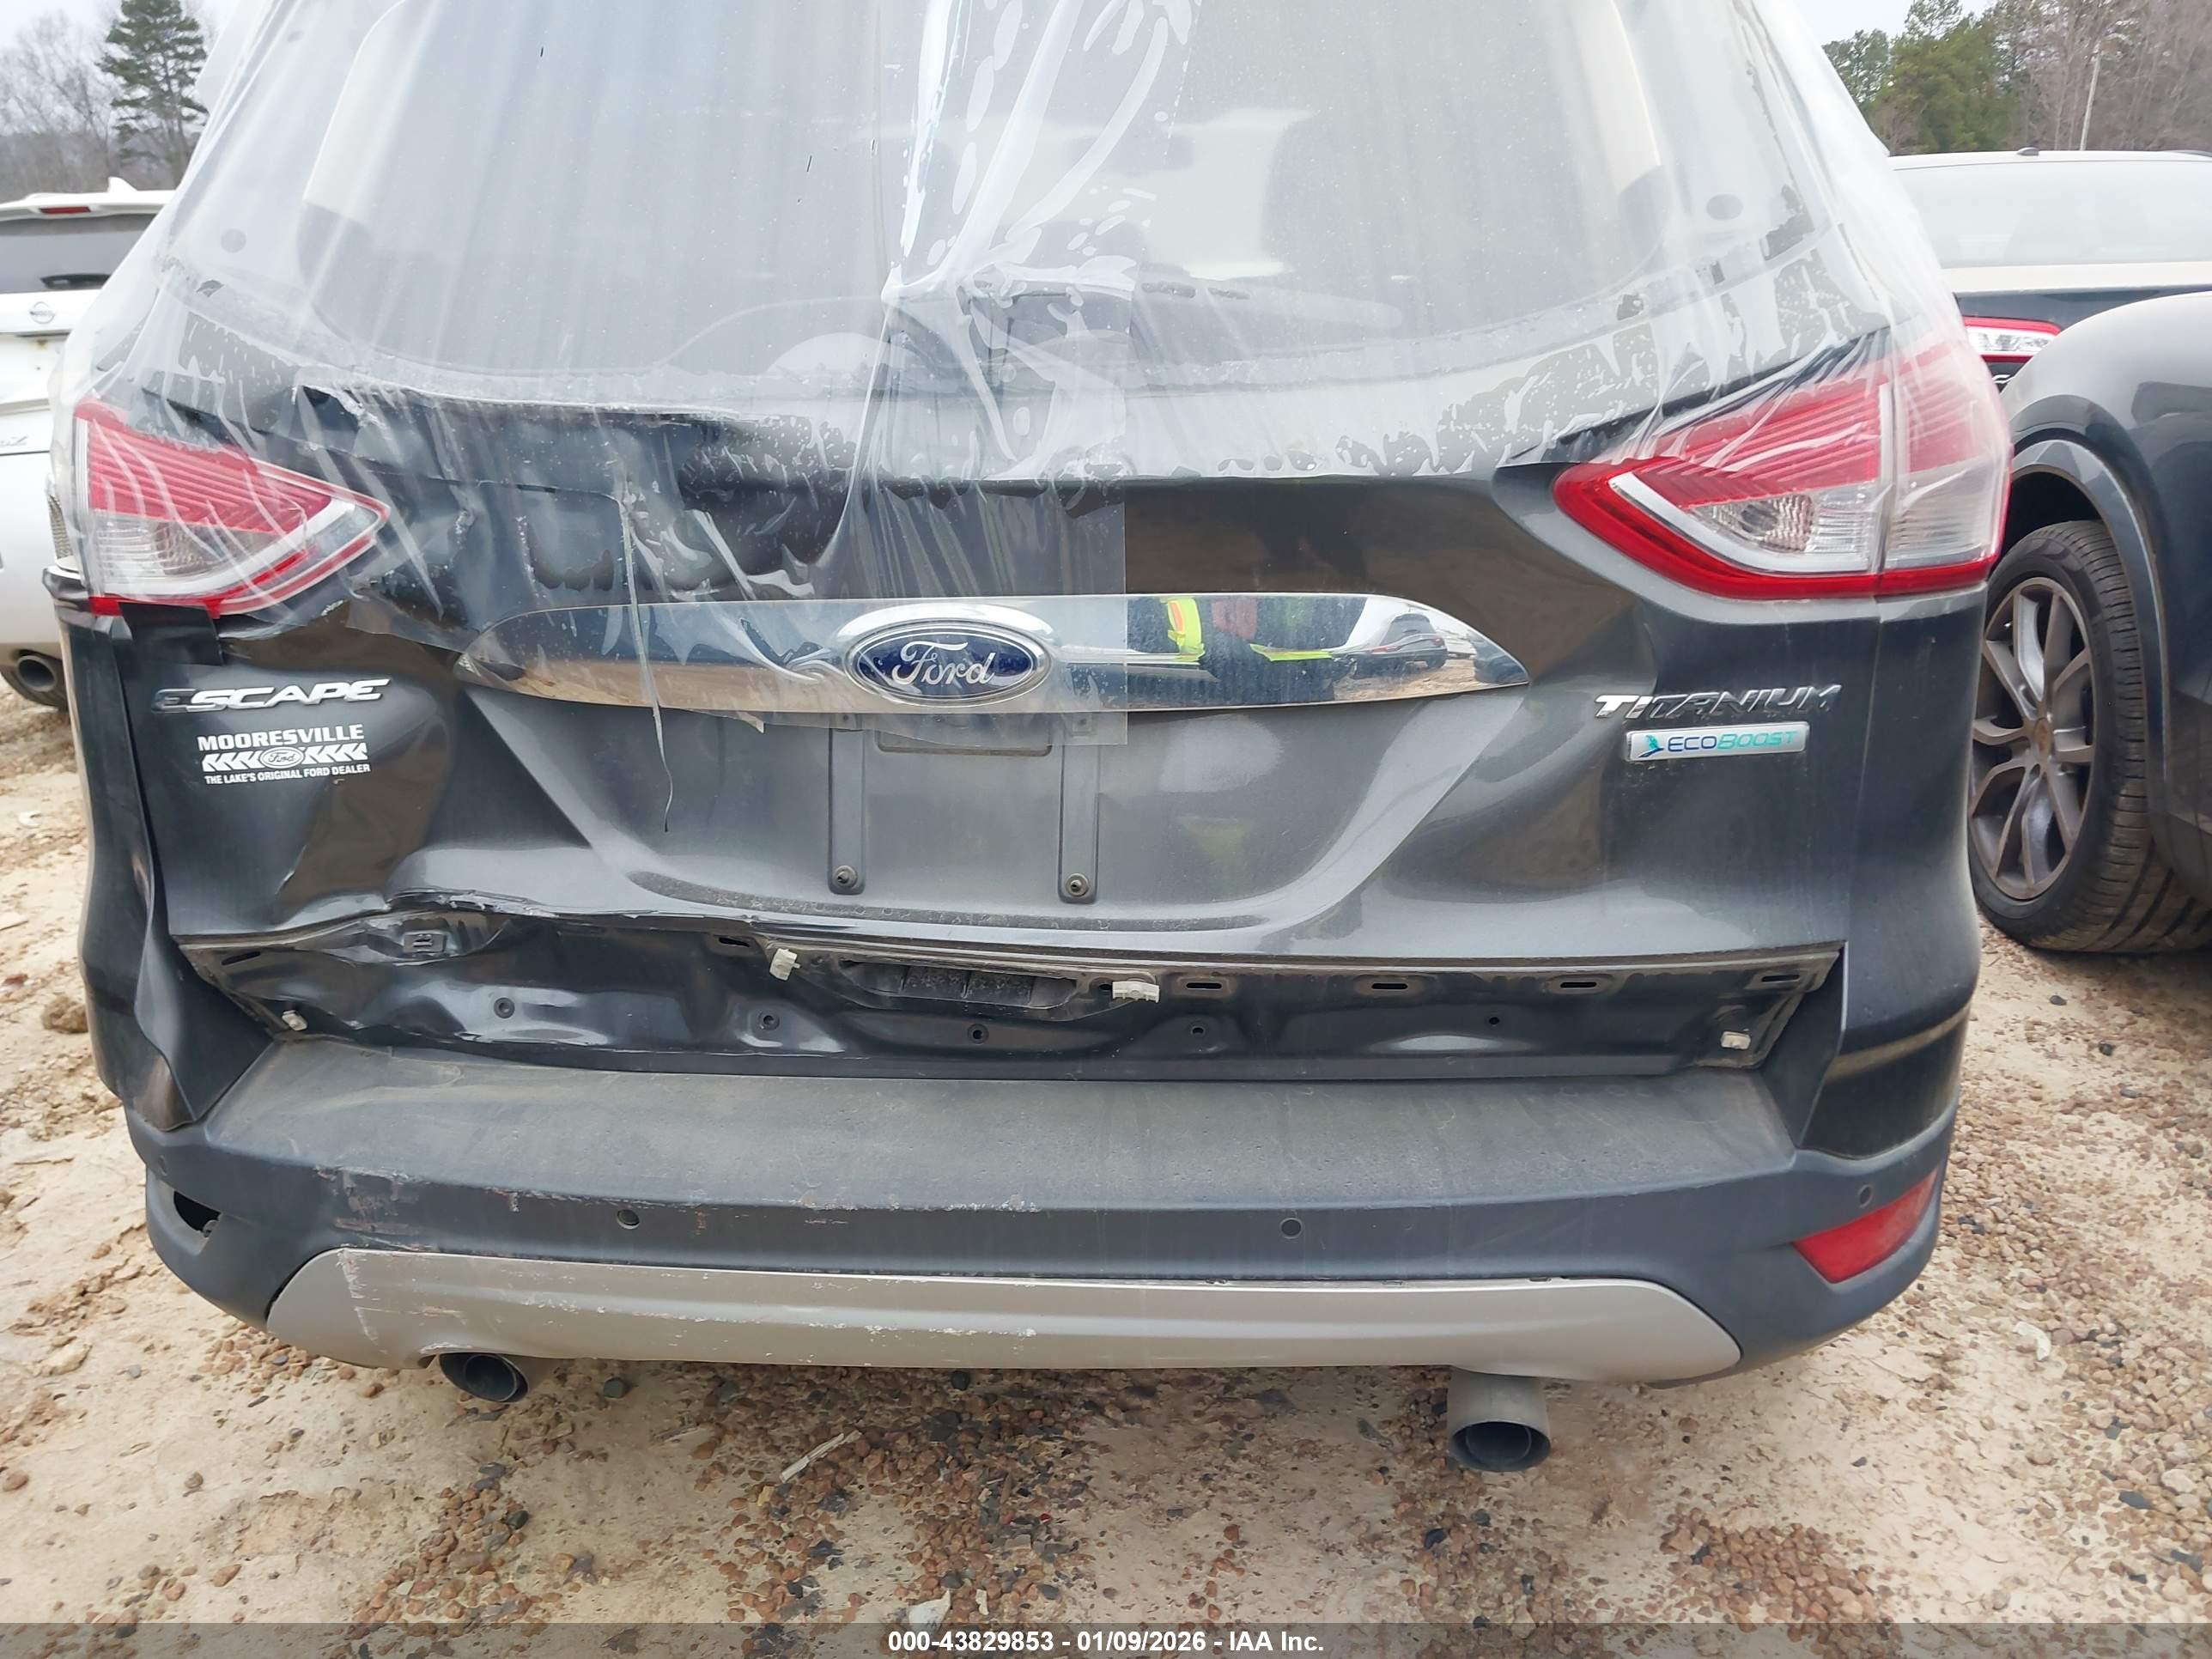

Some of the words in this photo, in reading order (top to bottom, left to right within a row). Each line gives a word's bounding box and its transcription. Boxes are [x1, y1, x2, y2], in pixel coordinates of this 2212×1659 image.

[891, 641, 996, 685] Ford
[151, 678, 391, 714] ESCAPE
[1594, 684, 1842, 720] TITANIUM
[197, 724, 365, 751] MOORESVILLE
[1668, 730, 1798, 753] ECOBOOST
[267, 751, 297, 763] Ford
[204, 775, 223, 785] THE
[223, 771, 257, 784] LAKE'S
[258, 769, 303, 781] ORIGINAL
[303, 767, 331, 778] FORD
[331, 763, 371, 776] DEALER
